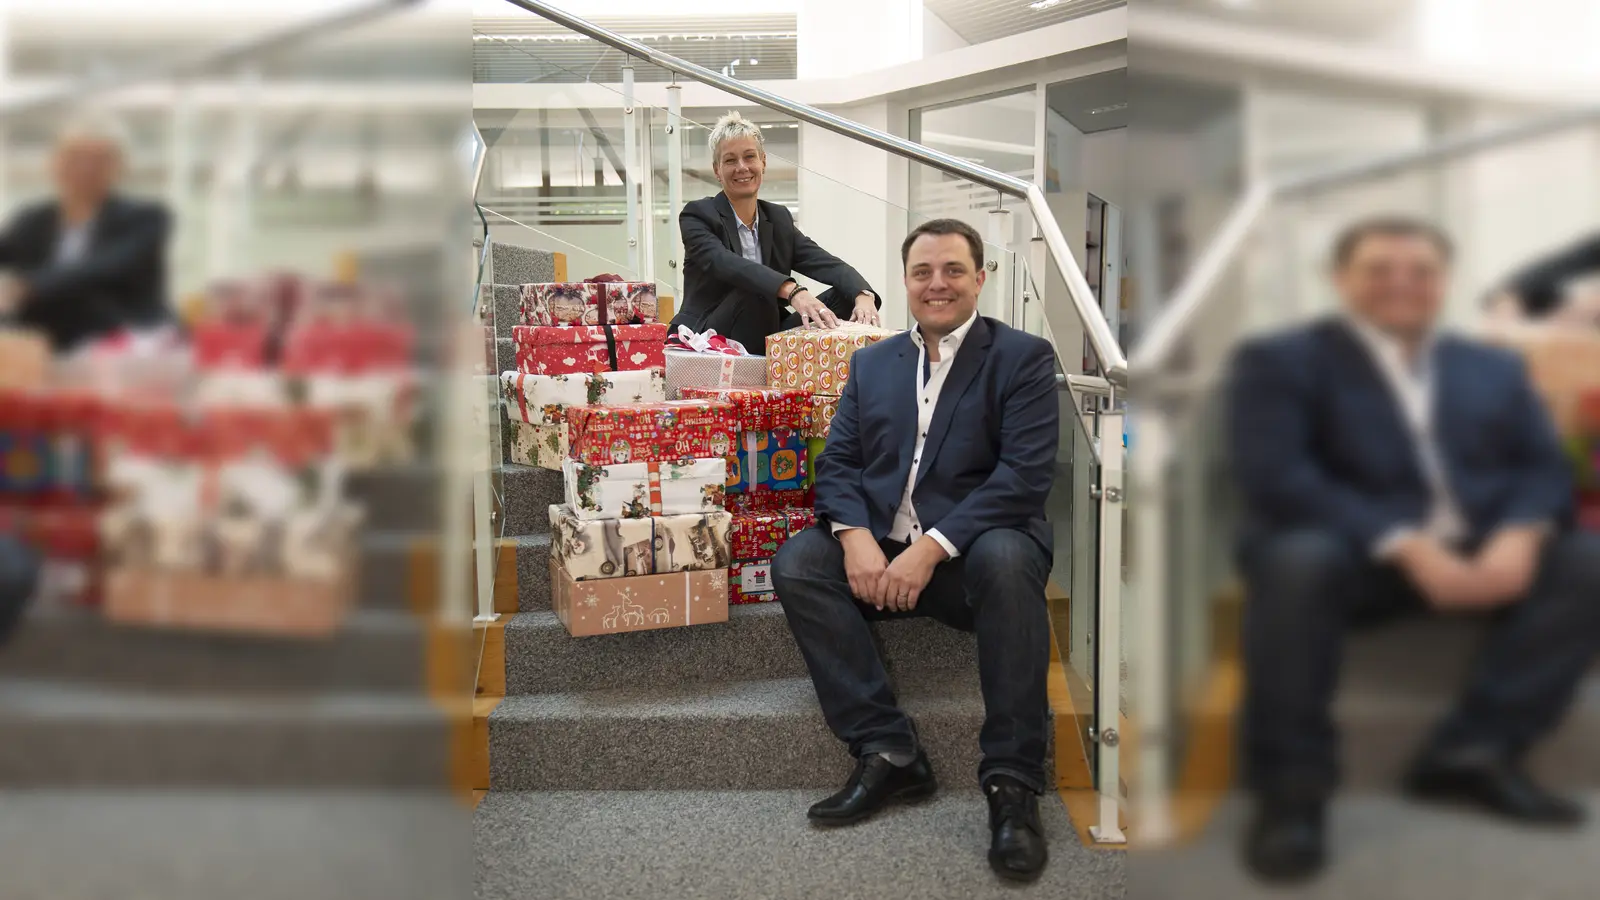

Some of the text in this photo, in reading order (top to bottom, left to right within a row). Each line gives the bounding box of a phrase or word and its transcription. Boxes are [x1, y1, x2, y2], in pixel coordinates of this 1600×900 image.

[639, 413, 652, 425] HO
[684, 417, 714, 425] CHRISTMAS
[675, 440, 690, 452] HO
[752, 535, 758, 543] Ho
